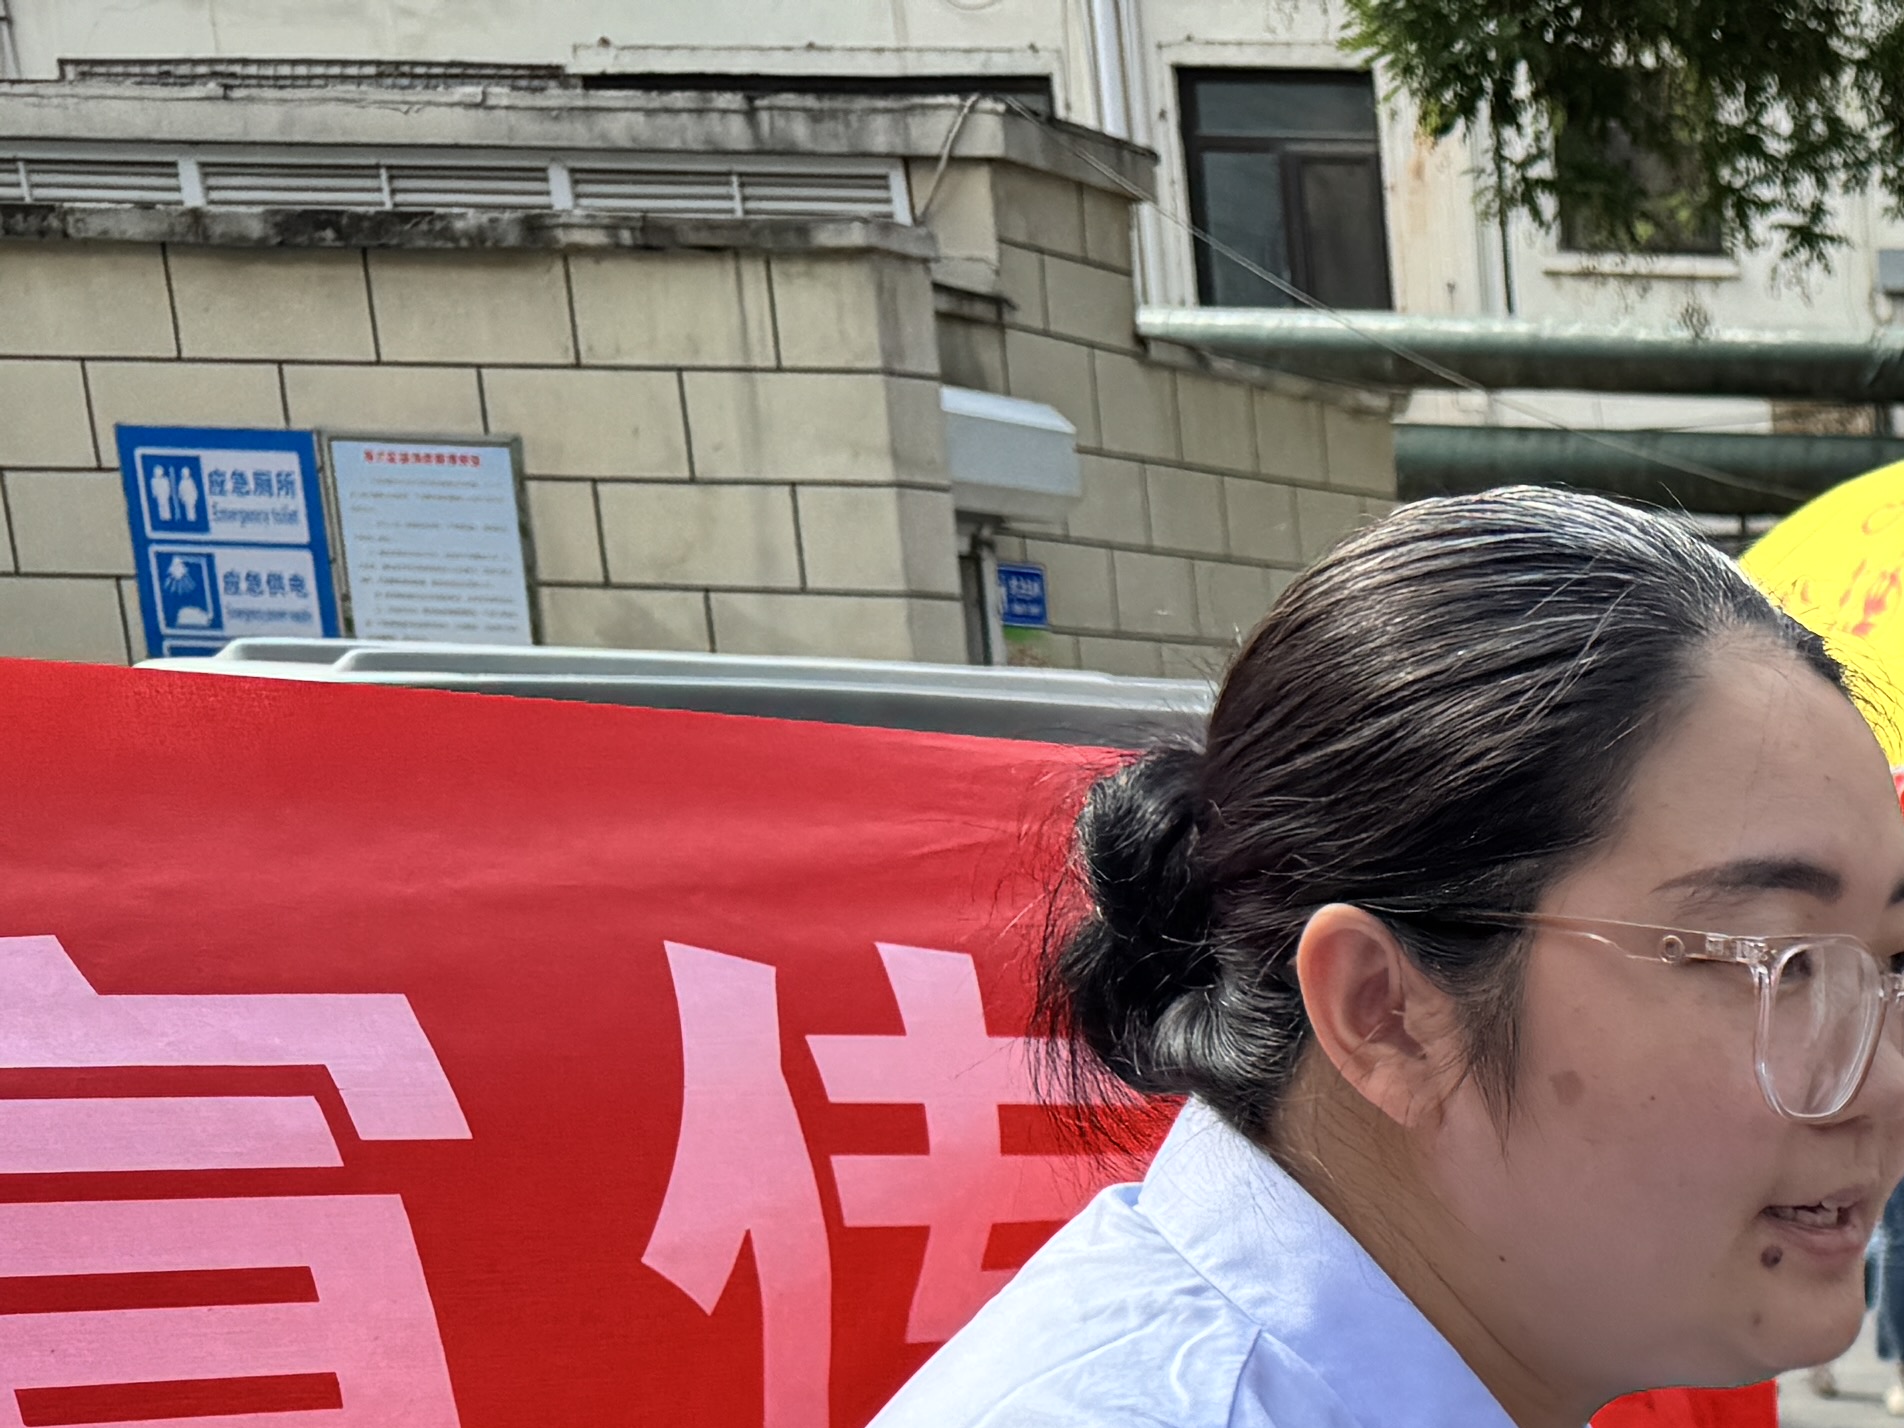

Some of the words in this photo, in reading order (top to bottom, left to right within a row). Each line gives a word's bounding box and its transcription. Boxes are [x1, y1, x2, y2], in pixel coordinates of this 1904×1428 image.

[207, 467, 296, 498] 应急厕所
[223, 568, 309, 599] 应急供电
